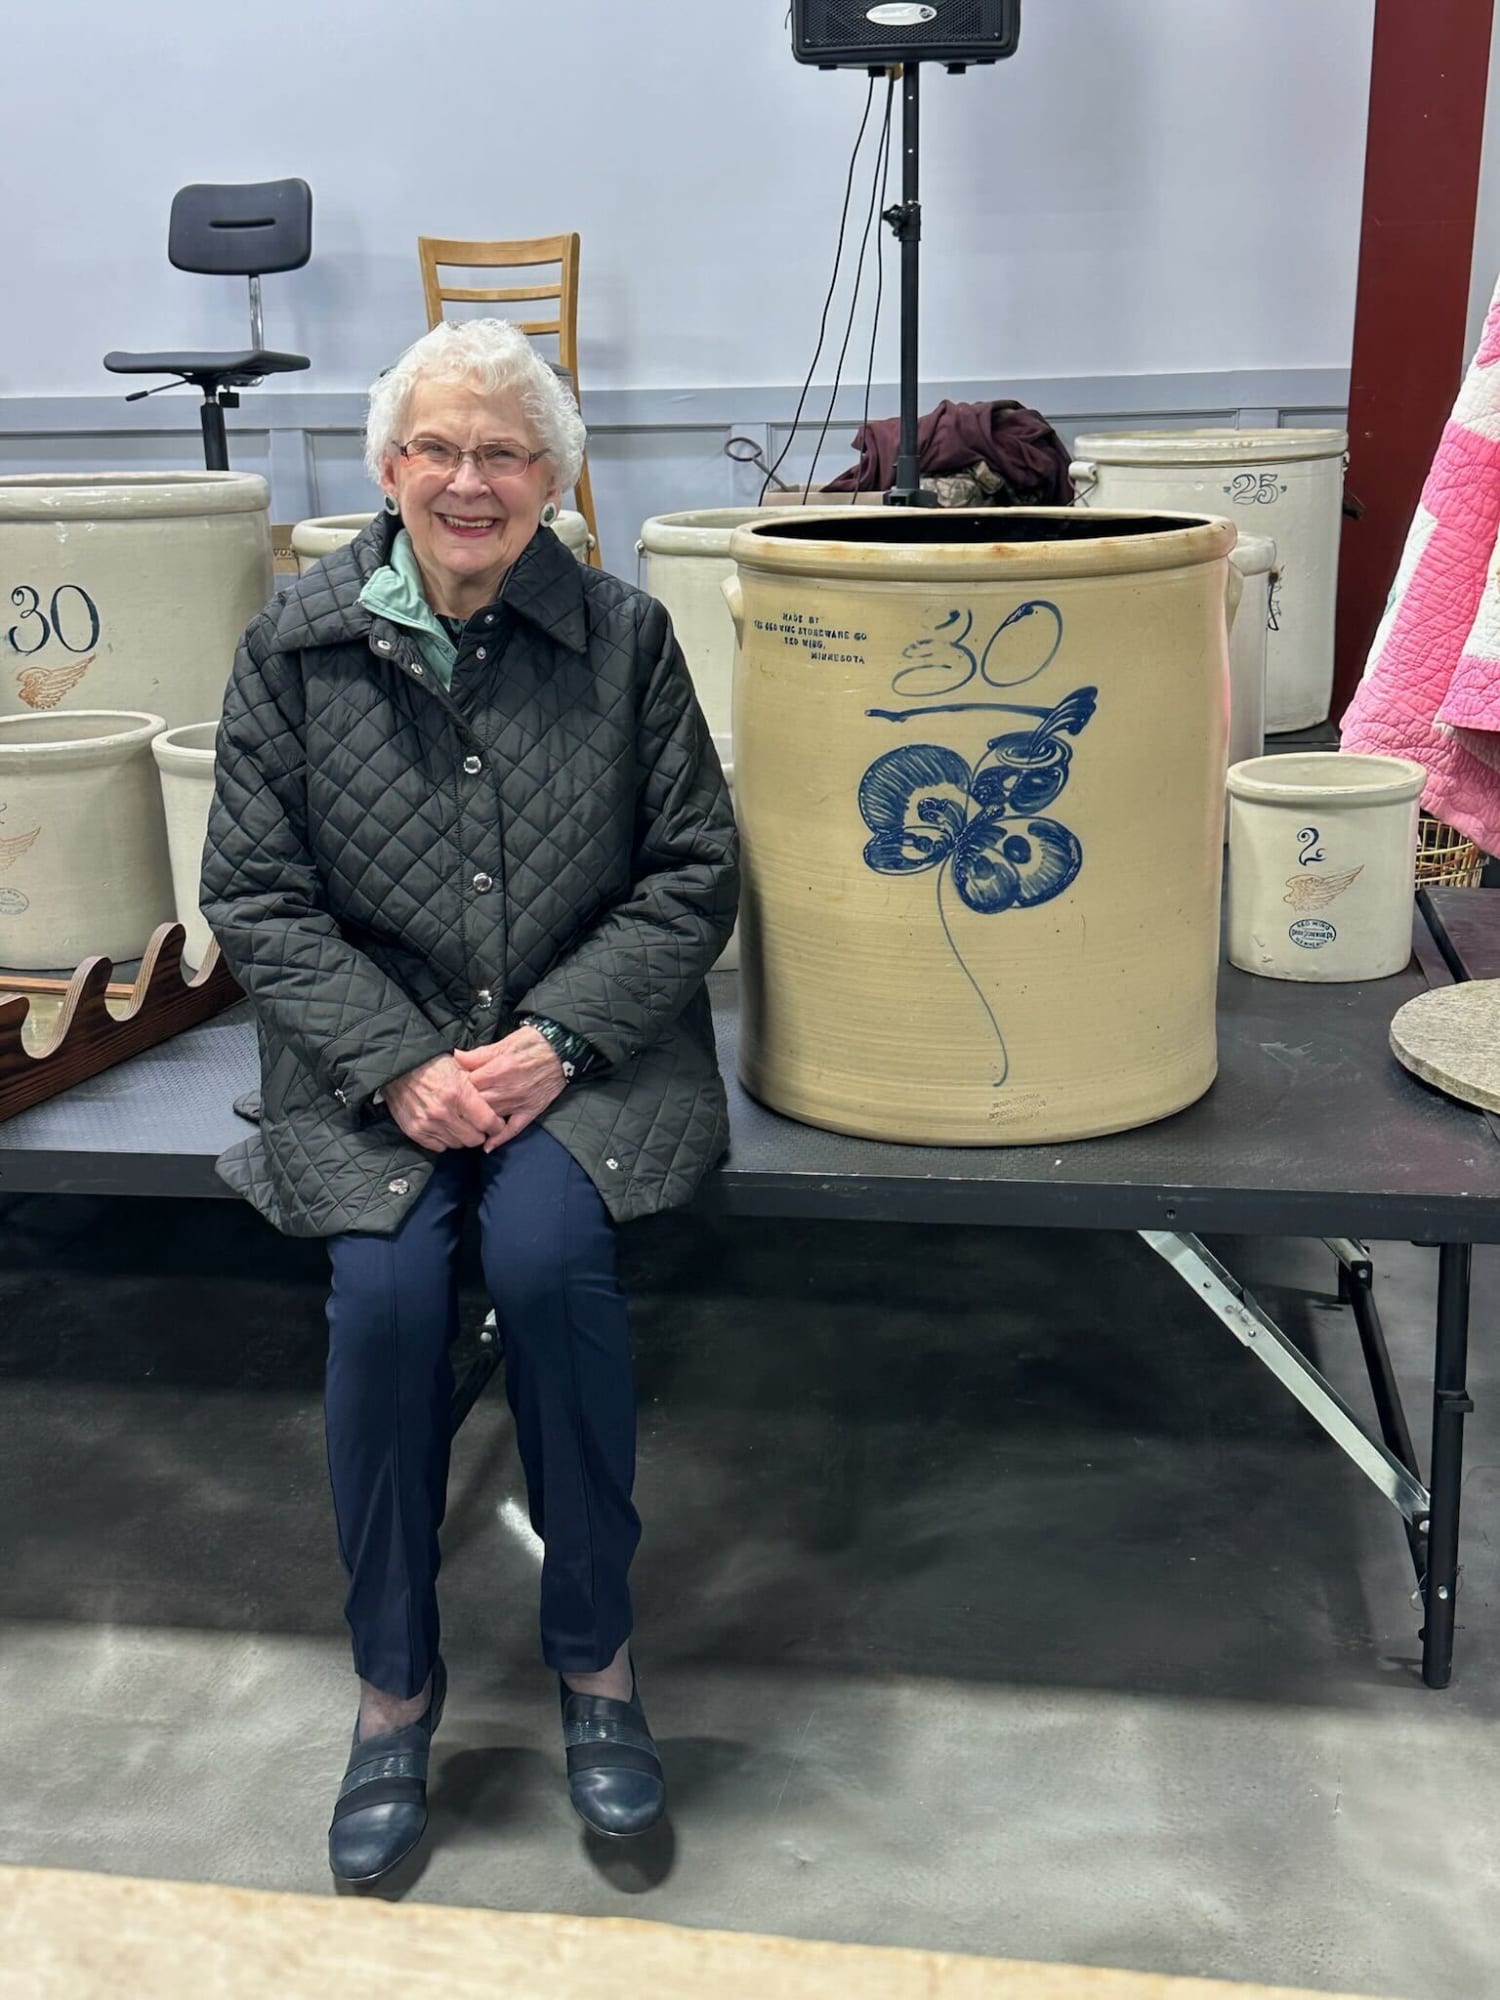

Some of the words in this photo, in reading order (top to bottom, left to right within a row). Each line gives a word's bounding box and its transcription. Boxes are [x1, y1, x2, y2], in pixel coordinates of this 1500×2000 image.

[1232, 473, 1279, 505] 25
[8, 584, 100, 656] 30
[782, 612, 803, 624] MADE
[810, 651, 865, 665] MINNESOTA
[891, 599, 1063, 697] 30
[1296, 827, 1327, 867] 2
